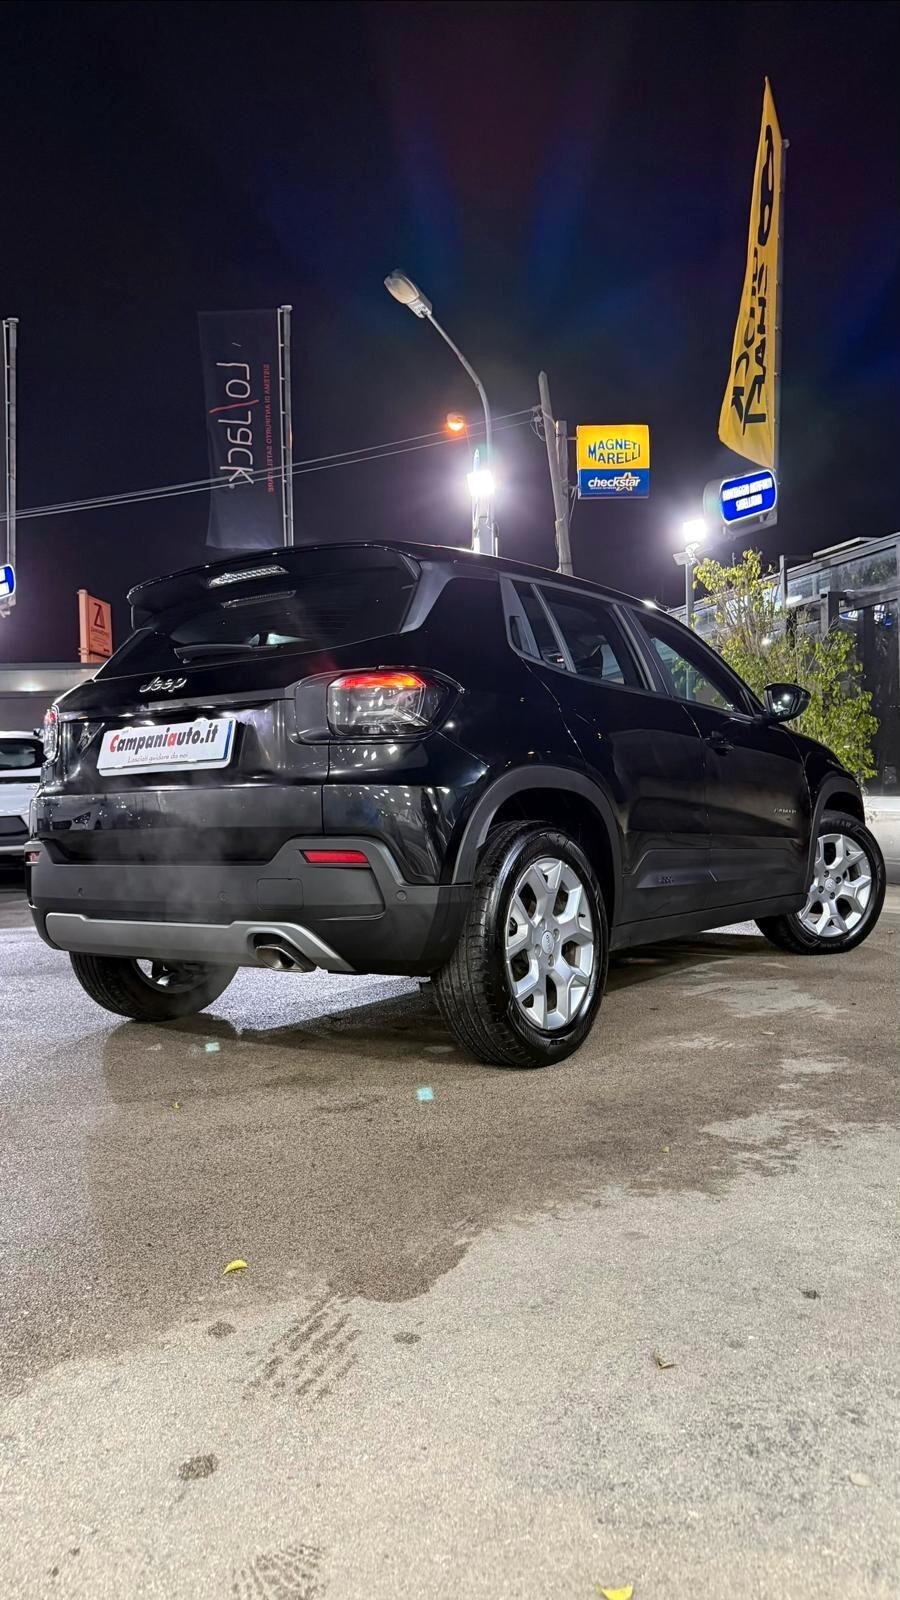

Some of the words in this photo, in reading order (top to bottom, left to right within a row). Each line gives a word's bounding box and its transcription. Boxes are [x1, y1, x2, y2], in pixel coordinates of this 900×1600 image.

[588, 438, 641, 457] MAGNETI
[588, 446, 641, 465] MARELLI
[588, 476, 641, 487] checkstar
[139, 676, 187, 693] Jeep
[109, 722, 219, 755] Campaniauto.it
